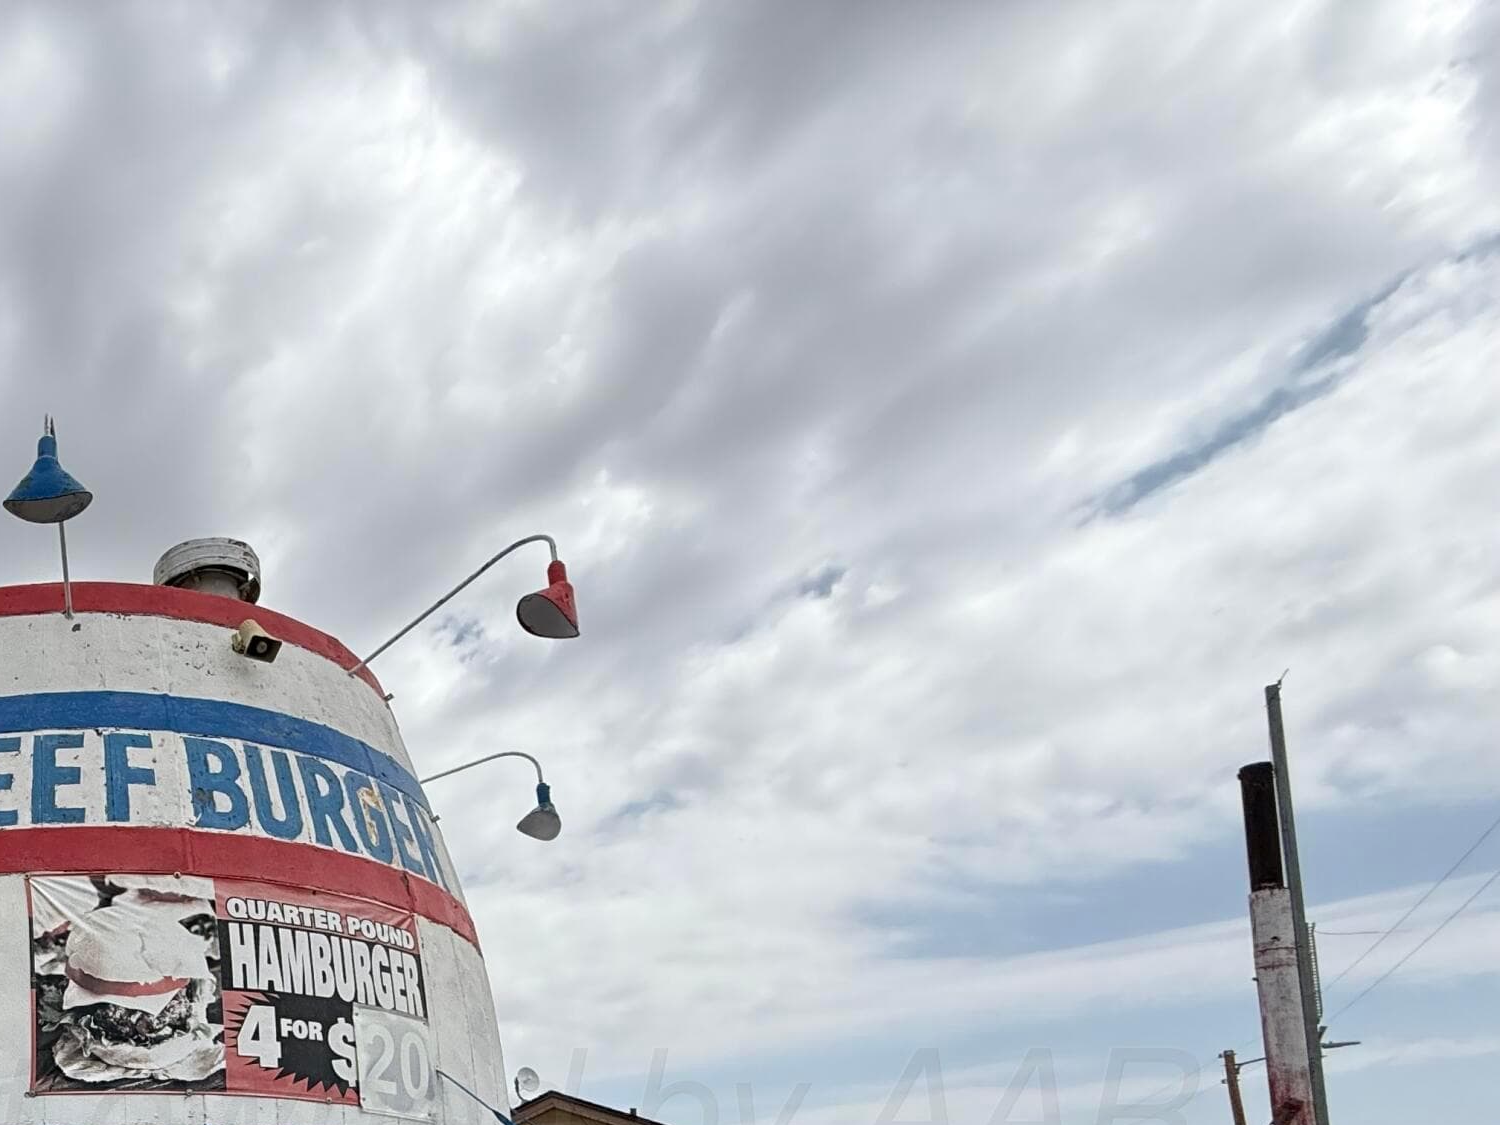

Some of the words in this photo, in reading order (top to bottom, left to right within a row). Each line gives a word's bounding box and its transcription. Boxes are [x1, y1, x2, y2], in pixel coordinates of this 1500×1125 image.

[184, 737, 448, 893] BURGER
[227, 897, 344, 934] QUARTER
[347, 917, 415, 951] POUND
[228, 921, 423, 1016] HAMBURGER
[237, 1005, 281, 1069] 4
[281, 1018, 322, 1042] FOR
